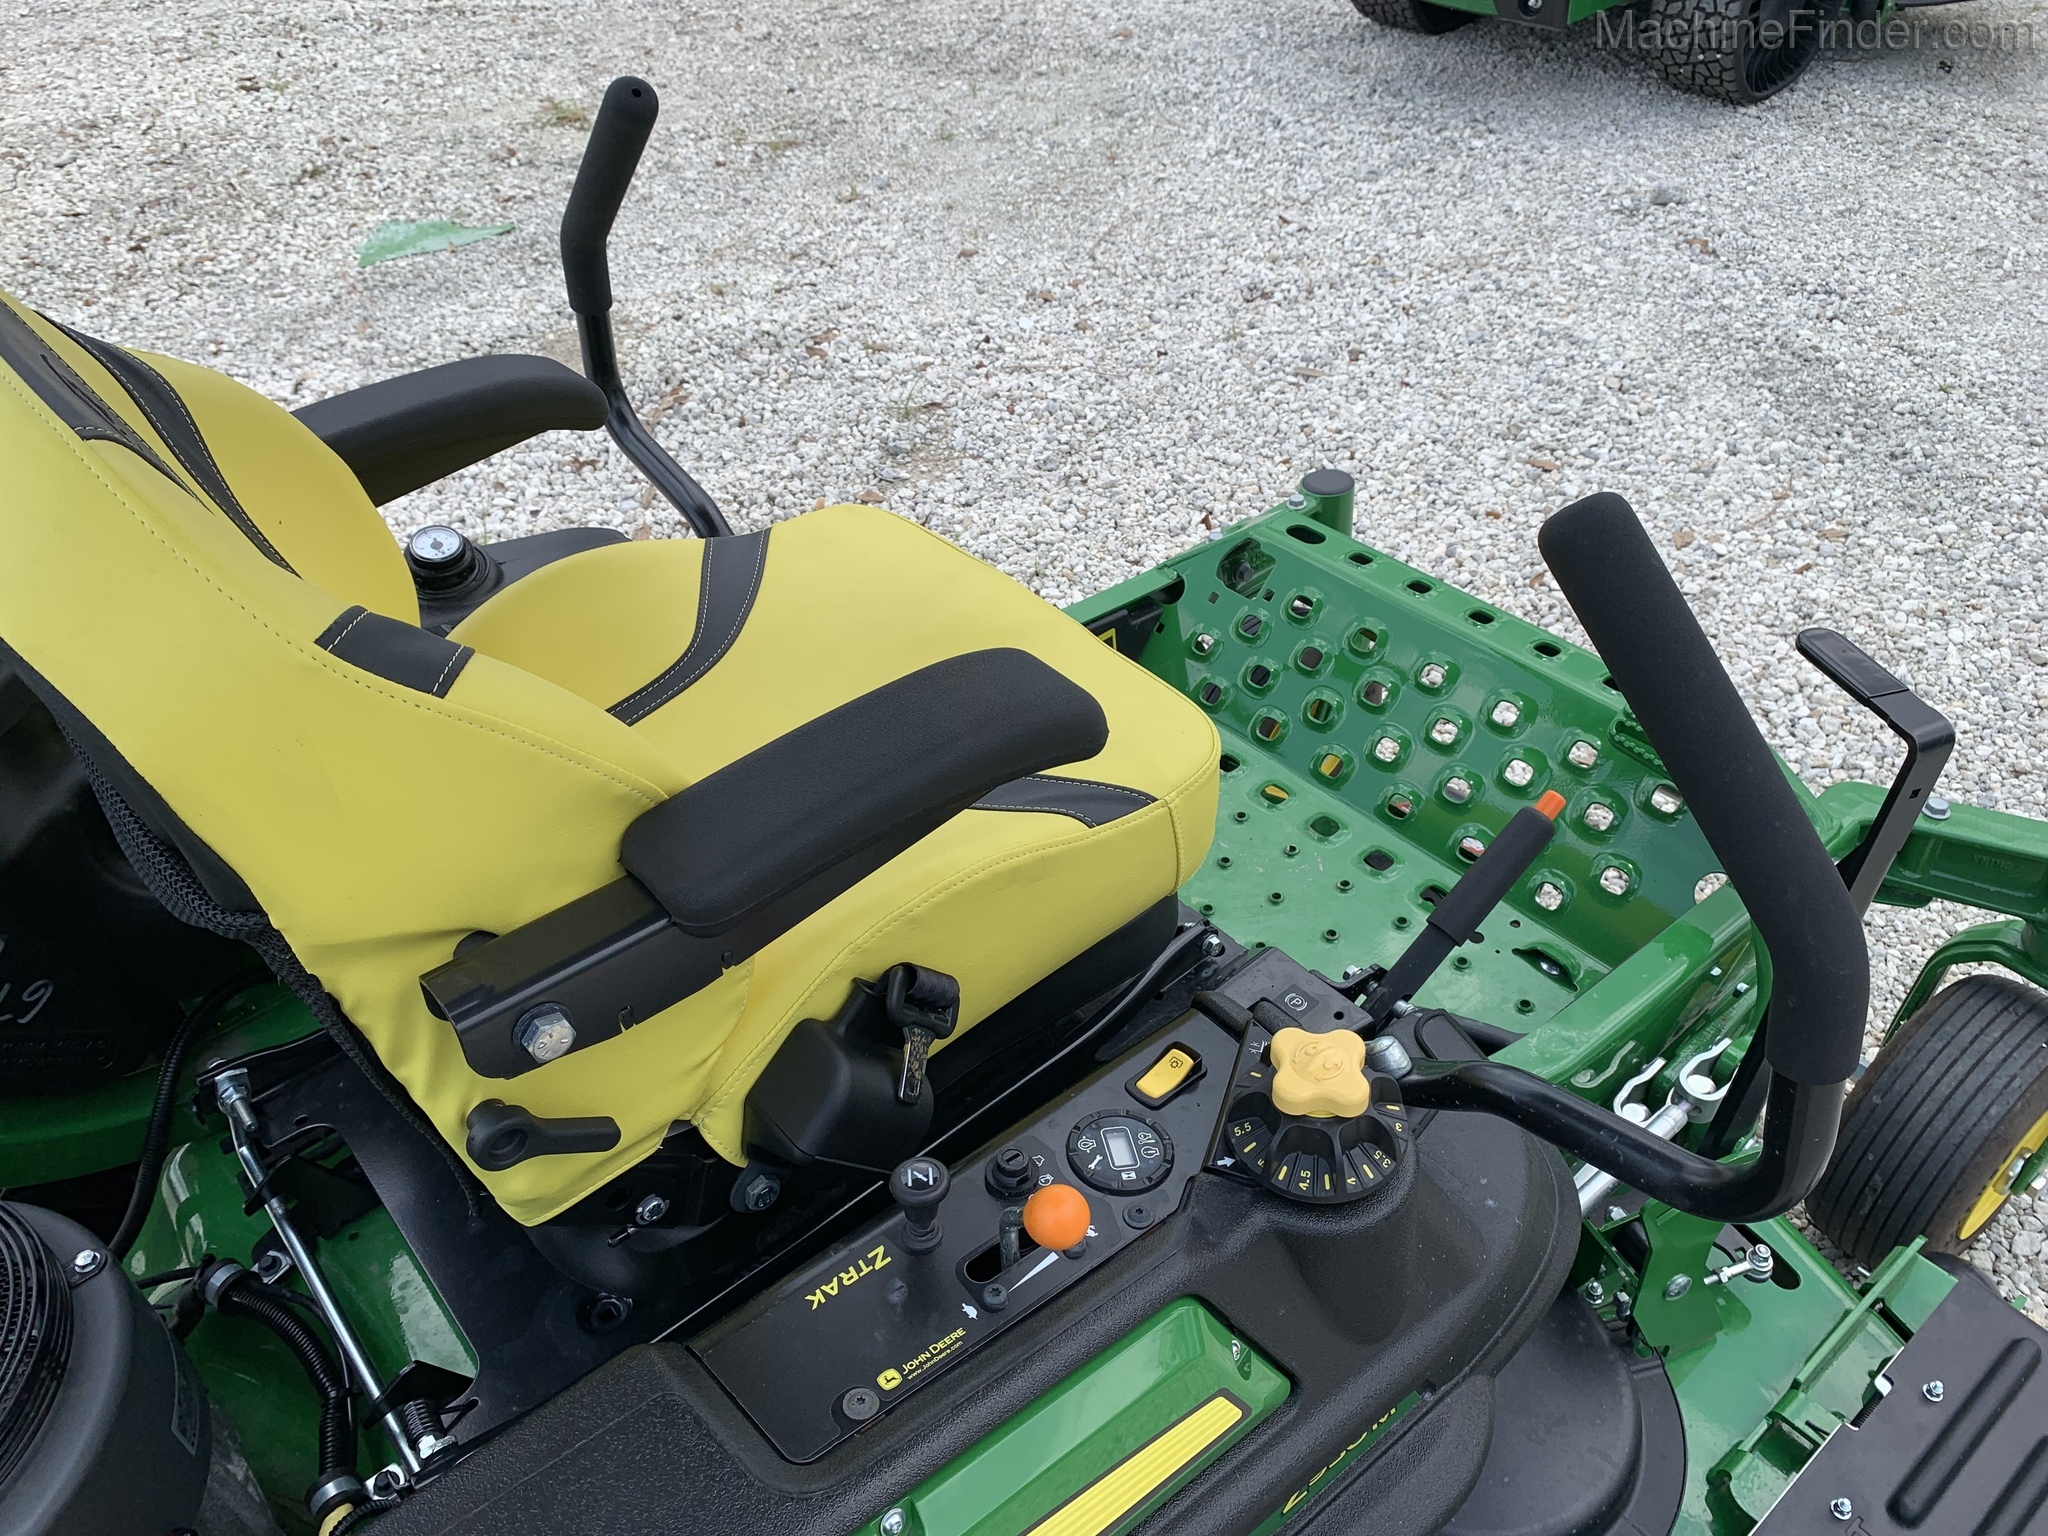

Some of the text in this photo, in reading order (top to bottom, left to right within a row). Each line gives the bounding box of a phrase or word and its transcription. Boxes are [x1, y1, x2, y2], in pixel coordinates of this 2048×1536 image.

[1234, 1122, 1251, 1136] 5.5
[1395, 1122, 1402, 1132] 3
[1373, 1150, 1391, 1168] 3.5
[1299, 1170, 1311, 1190] 4.5
[804, 1245, 892, 1311] ZTRAK
[902, 1327, 966, 1375] JOHN DEERE
[907, 1340, 964, 1380] www.JohnDeere.com
